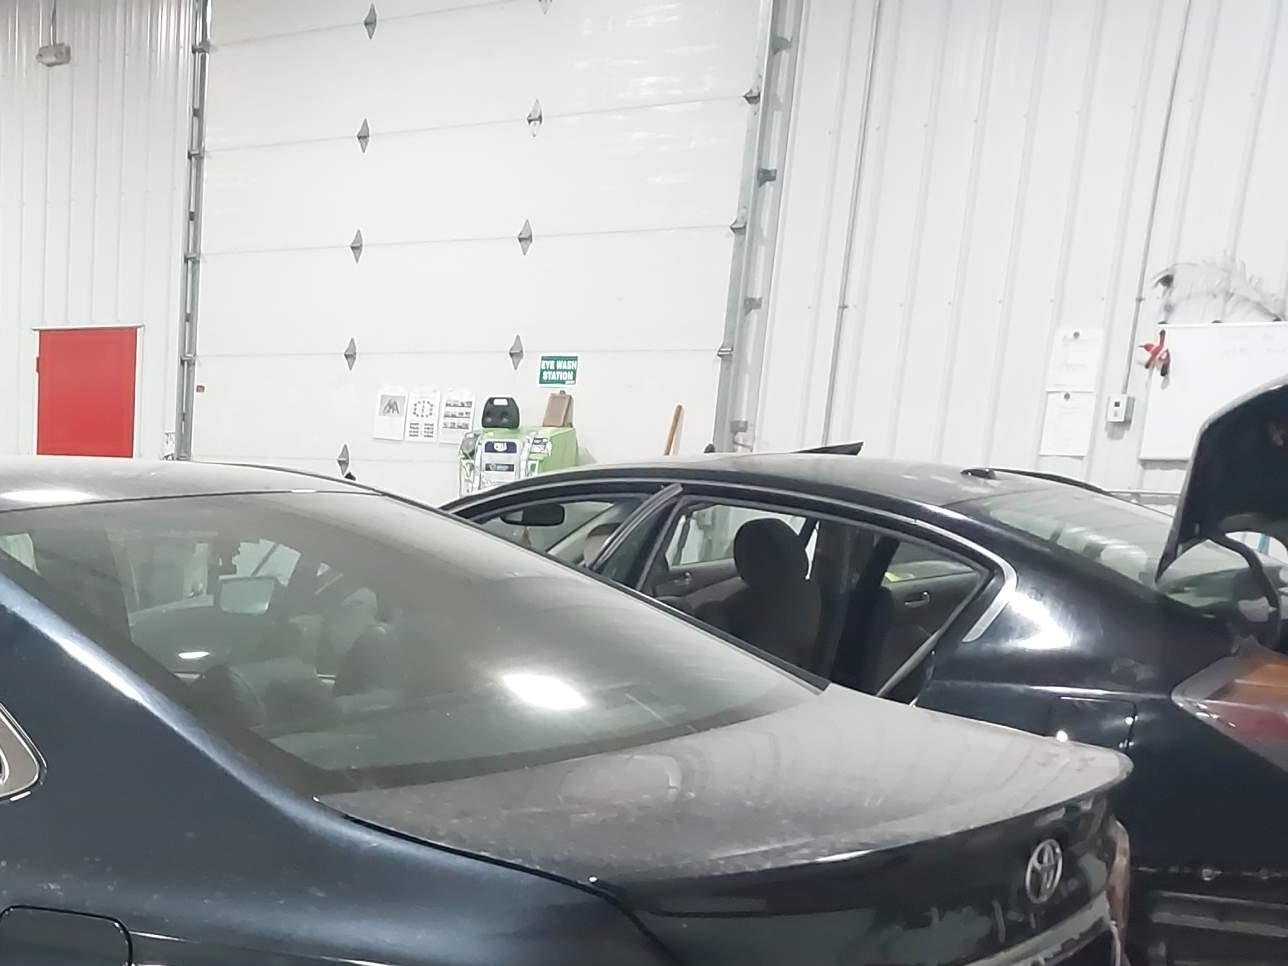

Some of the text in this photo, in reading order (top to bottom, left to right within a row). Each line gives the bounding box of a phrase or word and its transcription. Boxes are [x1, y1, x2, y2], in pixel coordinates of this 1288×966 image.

[541, 359, 578, 370] EYE WASH
[542, 370, 574, 381] STATION
